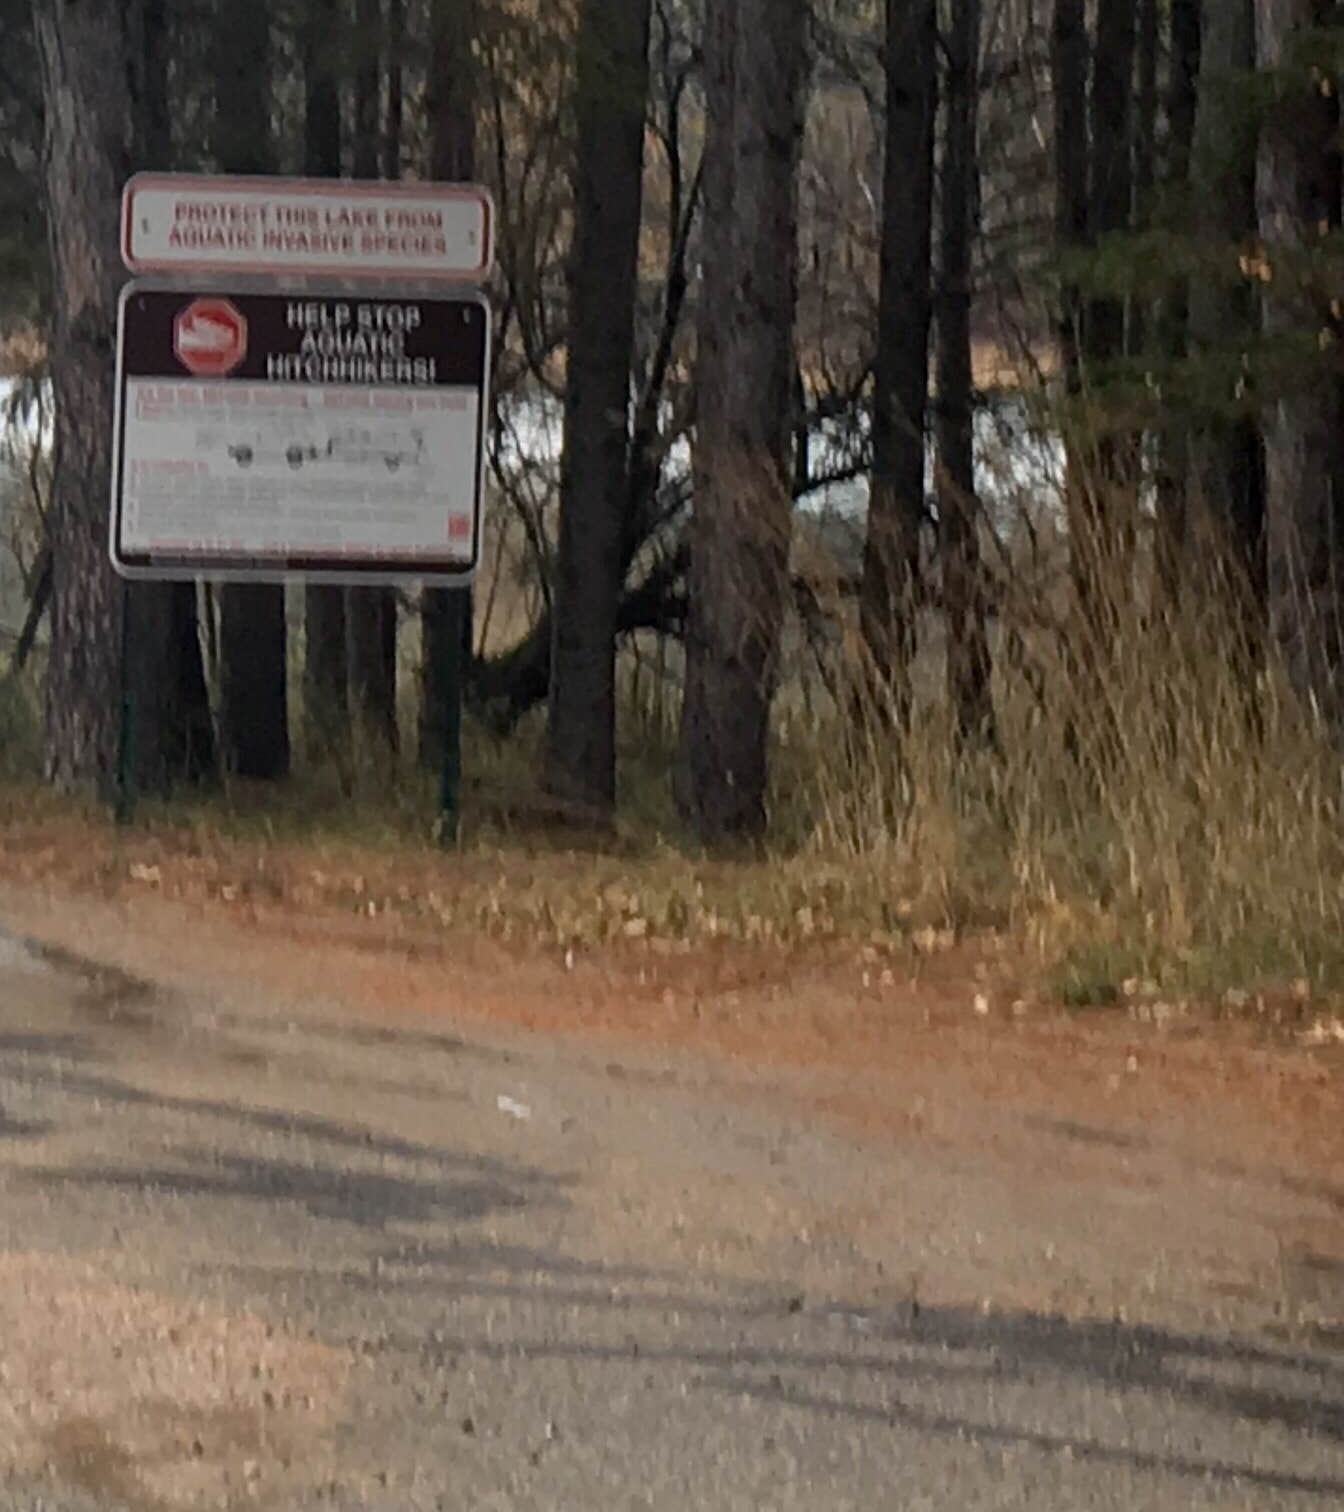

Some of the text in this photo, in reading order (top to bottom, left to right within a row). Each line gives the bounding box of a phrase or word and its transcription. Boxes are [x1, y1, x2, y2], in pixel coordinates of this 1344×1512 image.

[286, 302, 422, 331] HELP STOP
[301, 329, 405, 356] AQUATIC
